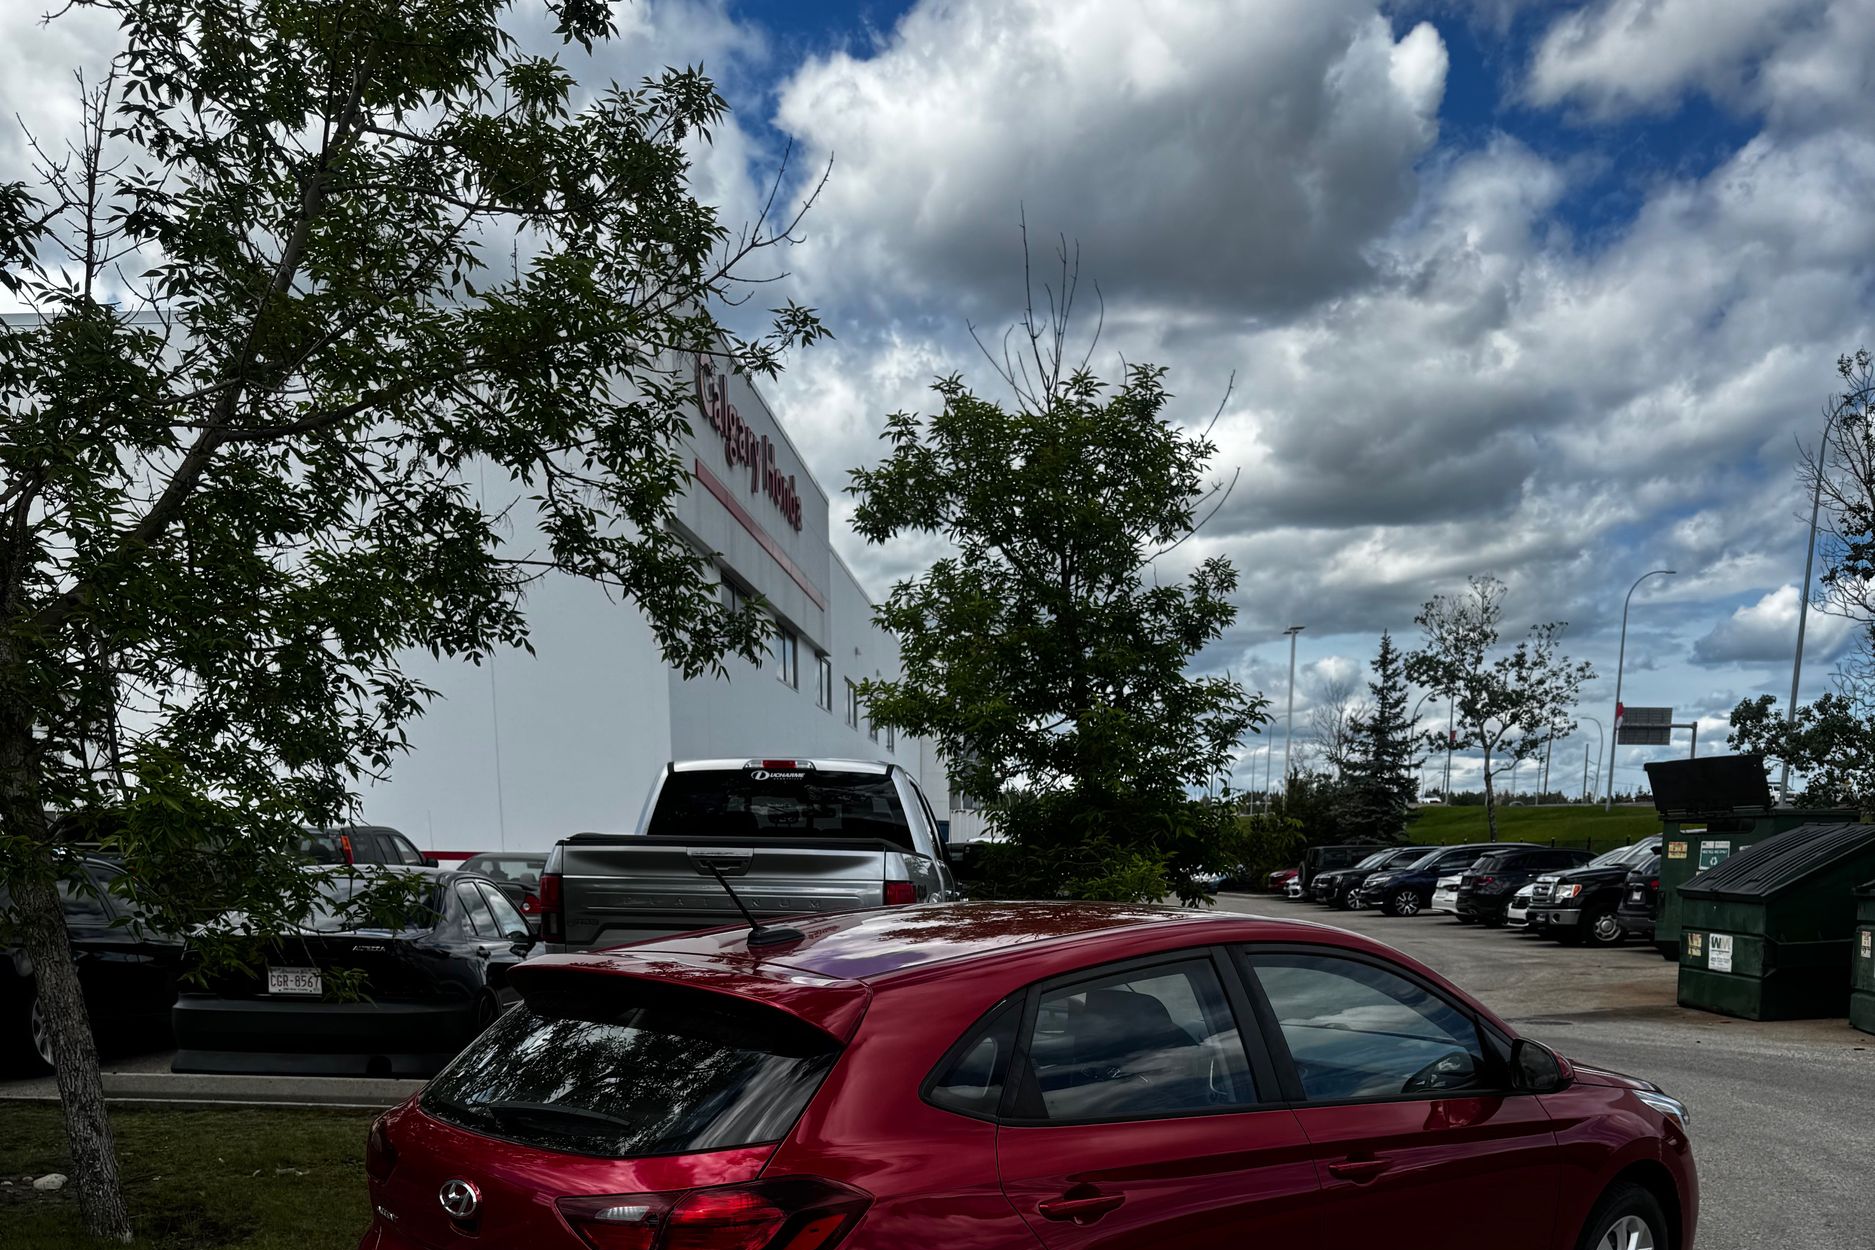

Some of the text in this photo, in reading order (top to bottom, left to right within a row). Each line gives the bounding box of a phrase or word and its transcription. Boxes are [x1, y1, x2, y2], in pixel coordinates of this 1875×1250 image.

[696, 352, 803, 532] Calgary Honda
[270, 974, 319, 988] CGR-8567
